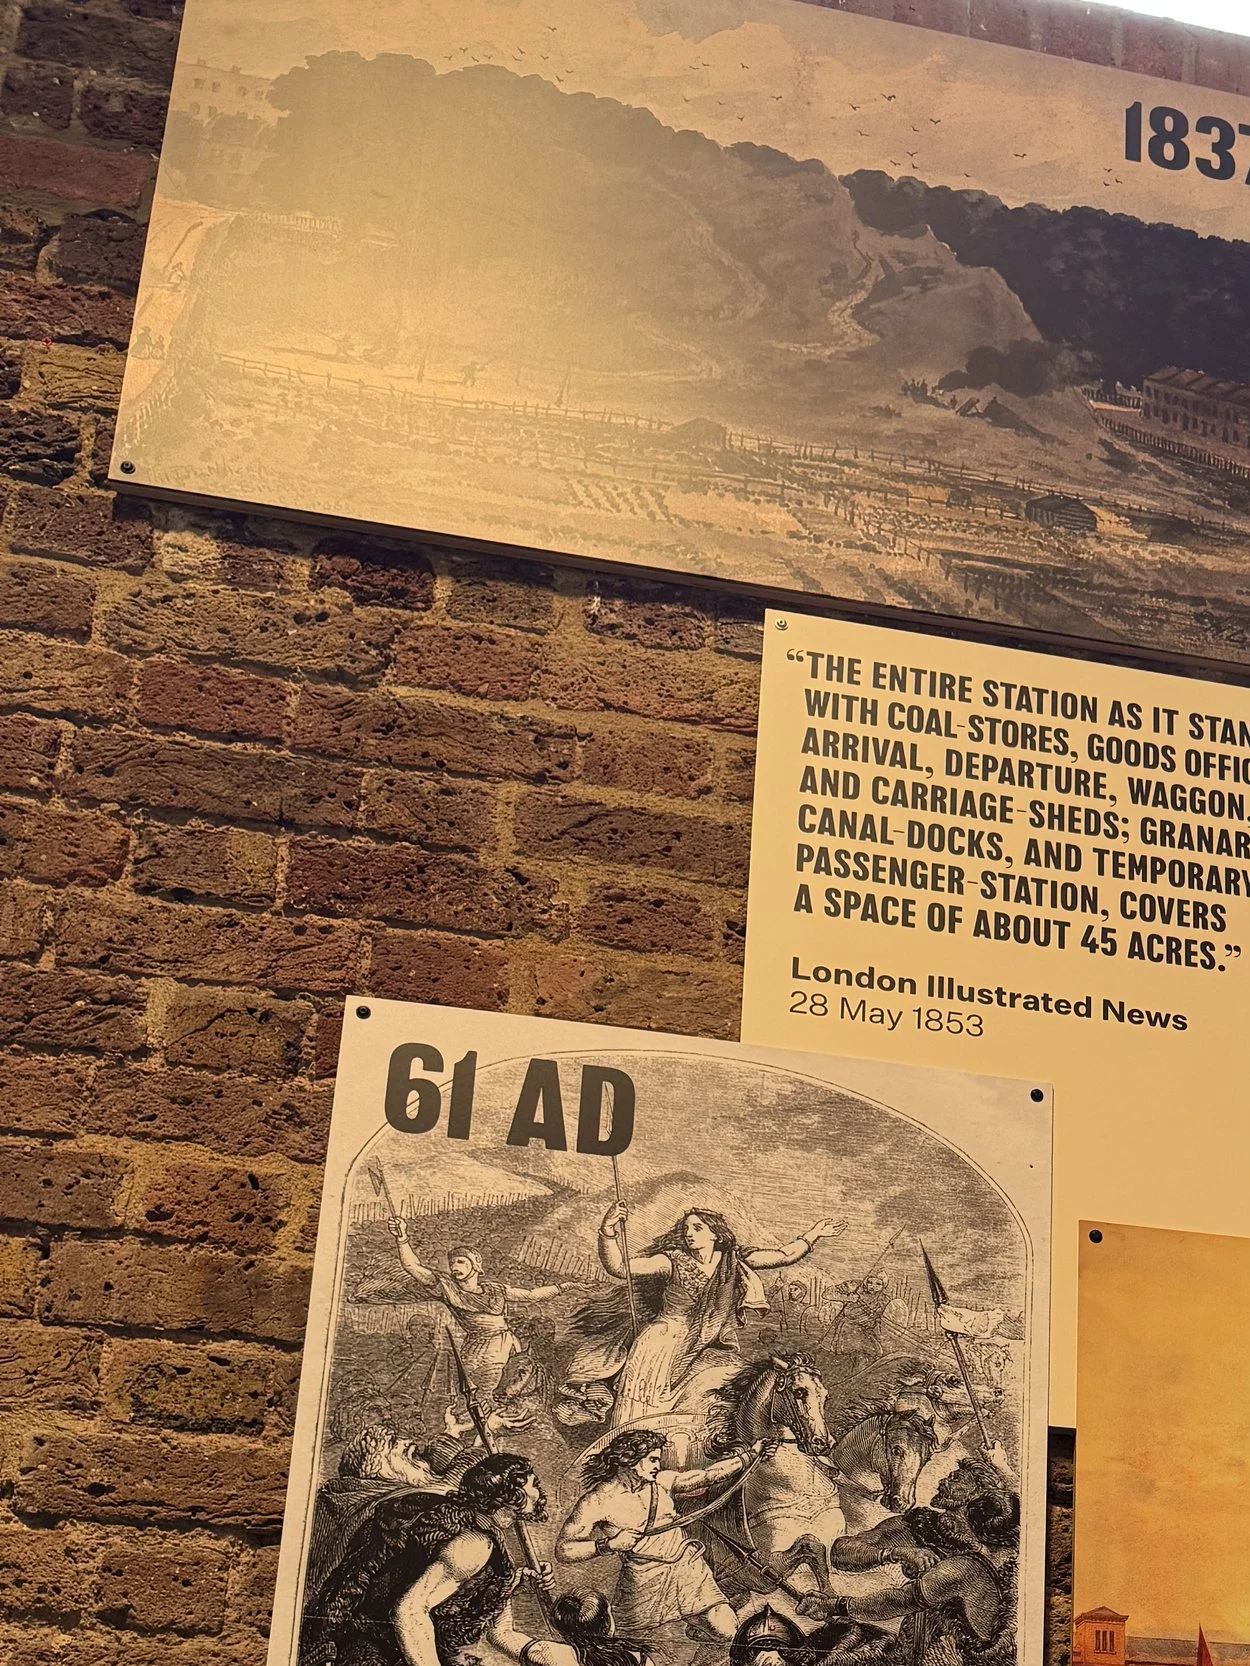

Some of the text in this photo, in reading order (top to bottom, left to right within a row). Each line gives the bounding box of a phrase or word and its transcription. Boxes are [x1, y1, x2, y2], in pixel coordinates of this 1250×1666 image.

[804, 688, 878, 726] WITH
[888, 702, 1083, 763] COAL-STORES,
[1087, 733, 1176, 773] GOODS
[872, 662, 972, 703] ENTIRE
[983, 680, 1097, 724] STATION
[1109, 700, 1142, 733] AS
[1153, 706, 1179, 736] IT
[799, 765, 860, 800] AND
[872, 776, 1129, 840] CARRIAGE-SHEDS;
[801, 727, 934, 779] ARRIVAL,
[945, 748, 1117, 807] DEPARTURE,
[798, 804, 1013, 869] CANAL-DOCKS,
[1025, 838, 1082, 872] AND
[794, 883, 813, 914] A
[824, 887, 916, 928] SPACE
[927, 902, 963, 934] OF
[973, 909, 1071, 949] ABOUT
[1081, 916, 1120, 956] 45
[796, 843, 1227, 933] PASSENGER-STATION, COVERS
[790, 991, 983, 1037] 28 May 1853
[792, 957, 1187, 1031] London Illustrated News
[384, 1042, 636, 1157] 61 AD
